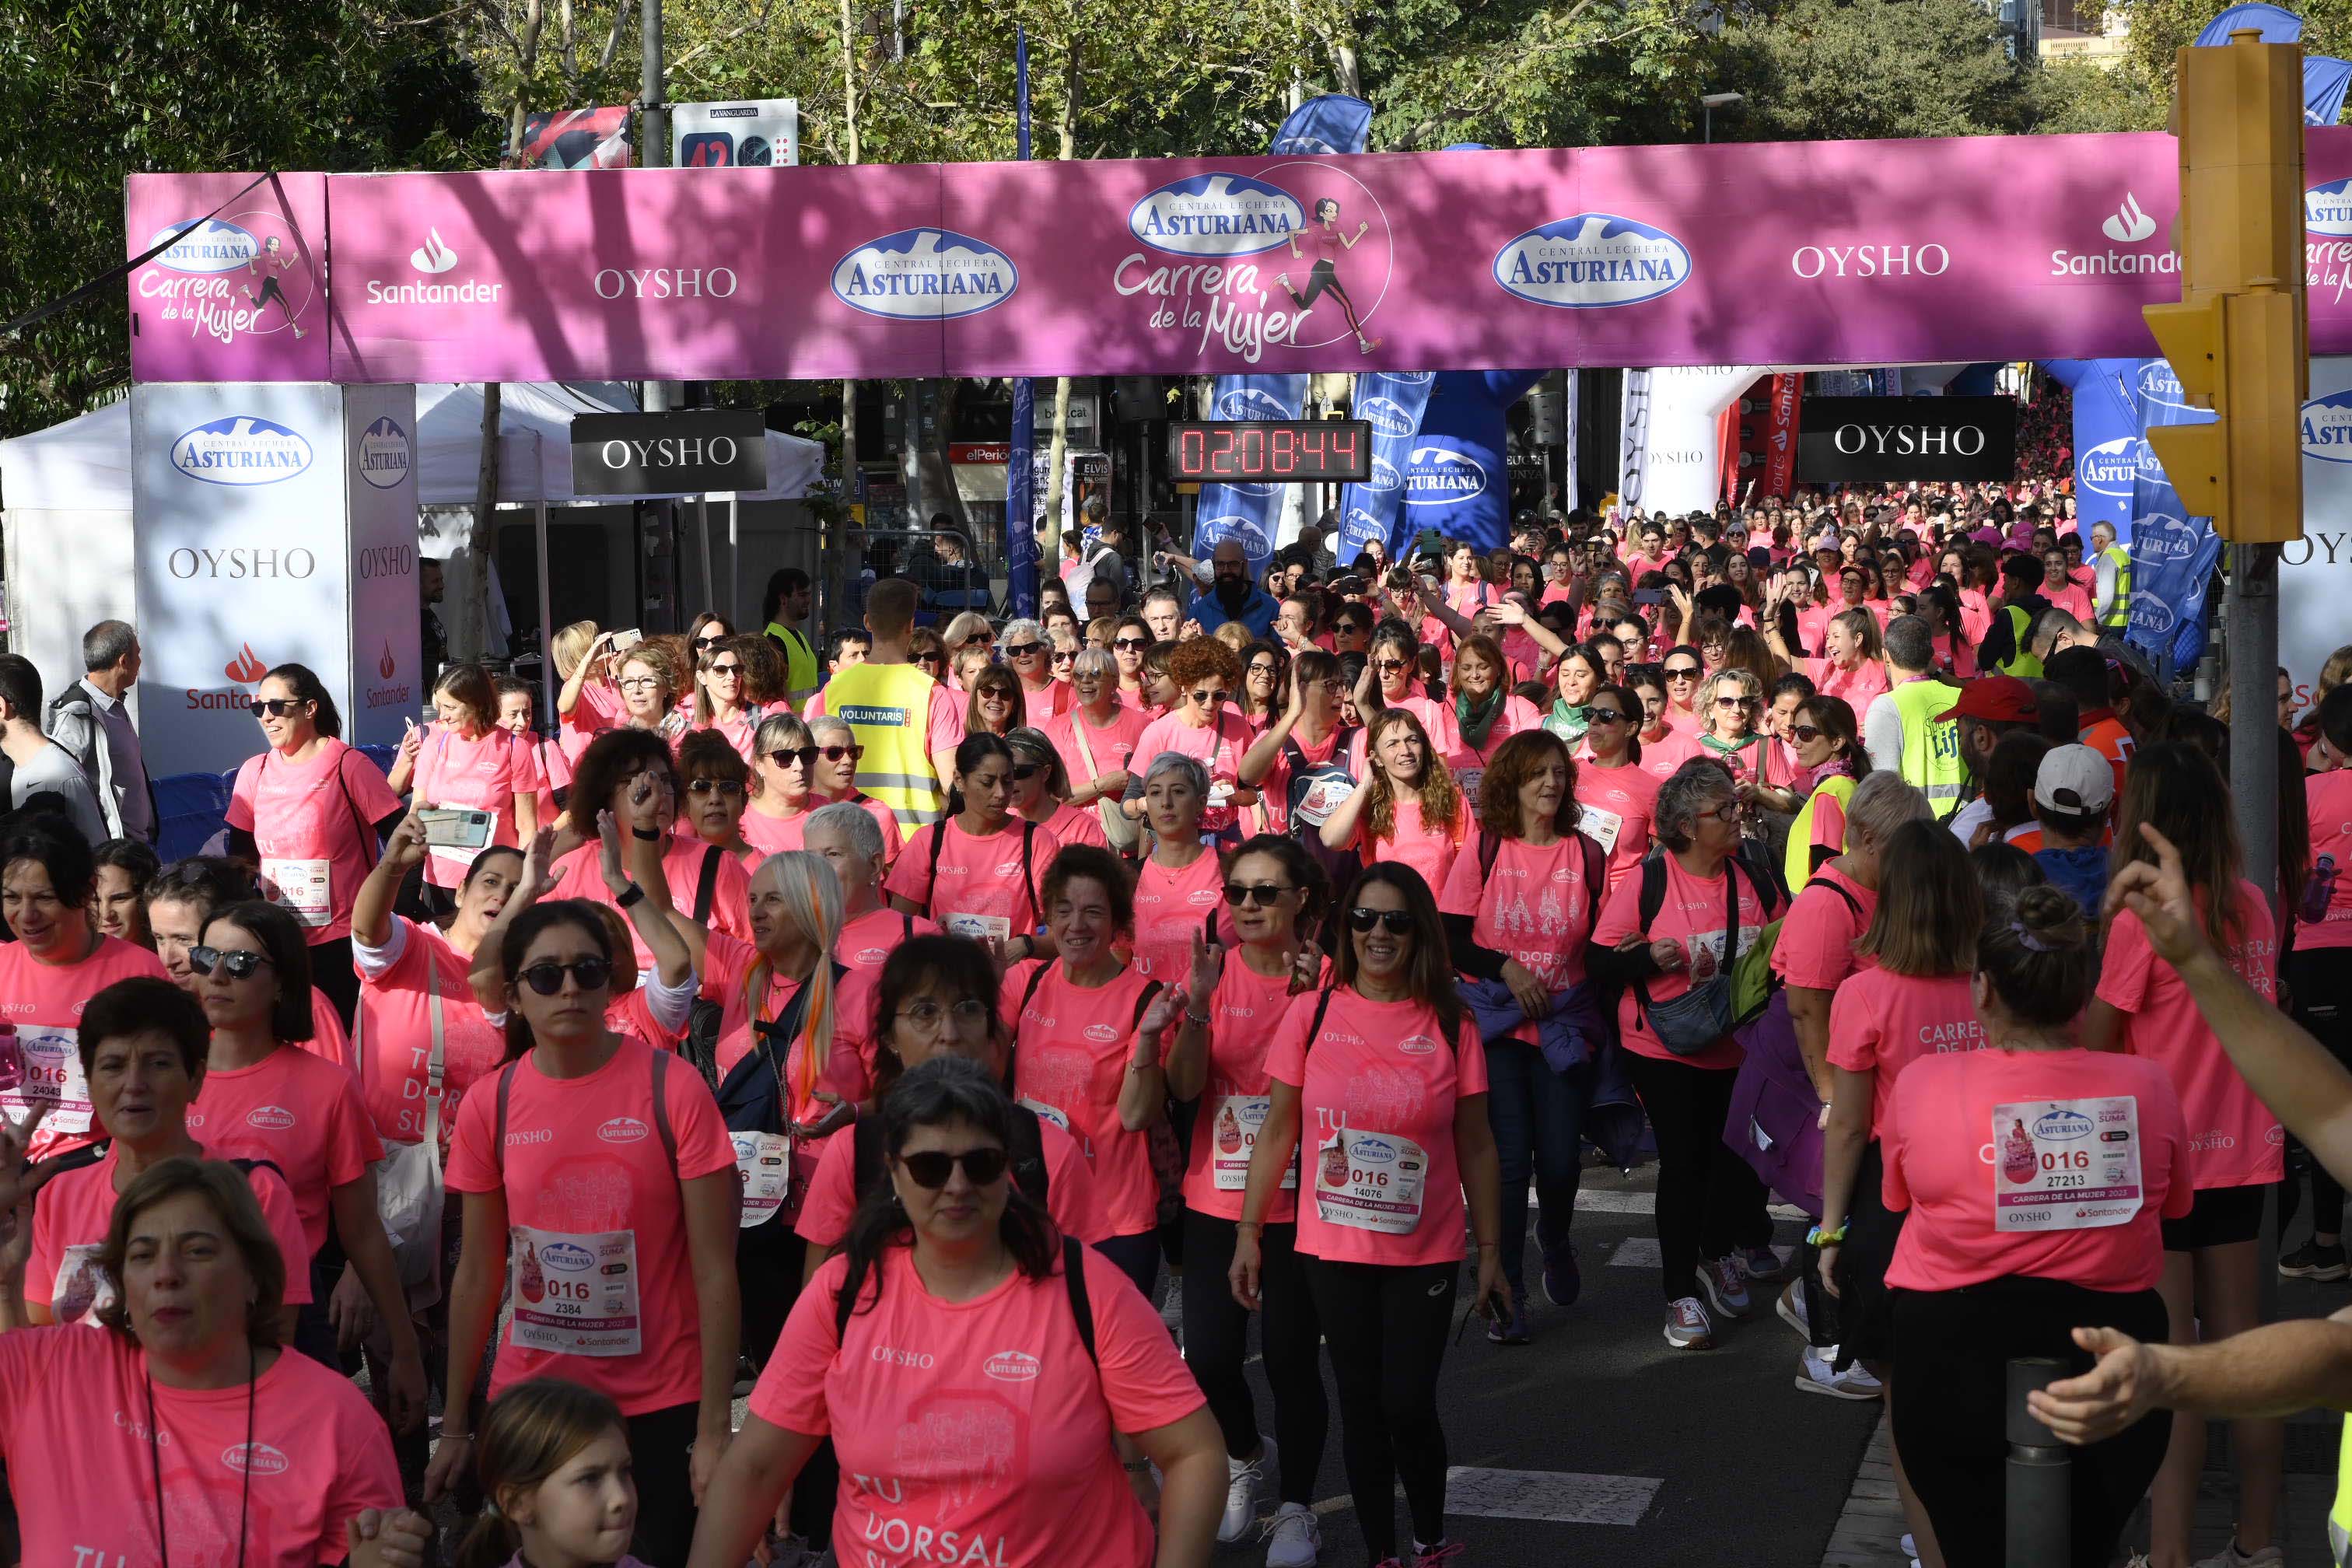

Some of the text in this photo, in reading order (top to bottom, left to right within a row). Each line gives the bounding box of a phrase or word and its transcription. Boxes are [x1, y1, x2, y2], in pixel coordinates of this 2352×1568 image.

[1169, 201, 1286, 211] CENTRAL LECHERA
[1142, 205, 1291, 236] ASTURIANA
[1538, 243, 1668, 257] CENTRAL LECHERA
[874, 259, 997, 269] CENTRAL LECHERA
[1508, 249, 1676, 285] ASTURIANA
[1791, 243, 1951, 278] OYSHO
[845, 262, 1003, 297] ASTURIANA
[1113, 253, 1259, 296] Carrera
[2323, 264, 2338, 286] la
[138, 269, 230, 299] Carrera
[367, 278, 502, 304] Santander
[595, 267, 737, 299] OYSHO
[161, 296, 265, 344] de la Mujer
[1150, 291, 1314, 363] de la Mujer
[1834, 423, 1986, 456] OYSHO
[182, 442, 303, 468] ASTURIANA
[362, 443, 408, 472] ASTURIANA
[602, 436, 737, 469] OYSHO
[1181, 429, 1355, 473] 02:08:44
[168, 548, 316, 579] OYSHO
[359, 544, 412, 579] OYSHO
[366, 685, 410, 709] Santander
[840, 709, 903, 722] VOLUNTARIS
[282, 887, 304, 896] 016
[31, 1042, 72, 1054] ASTURIANA
[1402, 1041, 1433, 1051] ASTURIANA
[30, 1066, 67, 1083] 016
[33, 1085, 61, 1097] 24043
[250, 1114, 291, 1125] ASTURIANA
[1315, 1107, 1346, 1129] TU
[2098, 1115, 2126, 1123] SUMA
[600, 1125, 645, 1138] ASTURIANA
[2036, 1123, 2090, 1136] ASTURIANA
[506, 1129, 552, 1147] OYSHO
[1352, 1146, 1393, 1160] ASTURIANA
[1400, 1148, 1421, 1157] SUMA
[2041, 1150, 2090, 1171] 016
[1352, 1169, 1388, 1186] 016
[2047, 1174, 2085, 1187] 27213
[1354, 1187, 1382, 1199] 14076
[2013, 1194, 2049, 1203] CARRERA
[1327, 1194, 1354, 1205] CARRERA
[1374, 1202, 1396, 1210] MUJER
[1321, 1206, 1353, 1220] OYSHO
[2009, 1210, 2052, 1223] OYSHO
[2087, 1206, 2131, 1217] Santander
[1379, 1216, 1412, 1227] Santander
[544, 1251, 591, 1265] ASTURIANA
[548, 1279, 590, 1300] 016
[555, 1303, 582, 1314] 2384
[523, 1328, 558, 1342] OYSHO
[587, 1337, 630, 1346] Santander
[871, 1345, 934, 1369] OYSHO
[987, 1361, 1038, 1374] ASTURIANA
[865, 1510, 1009, 1568] DORSAL
